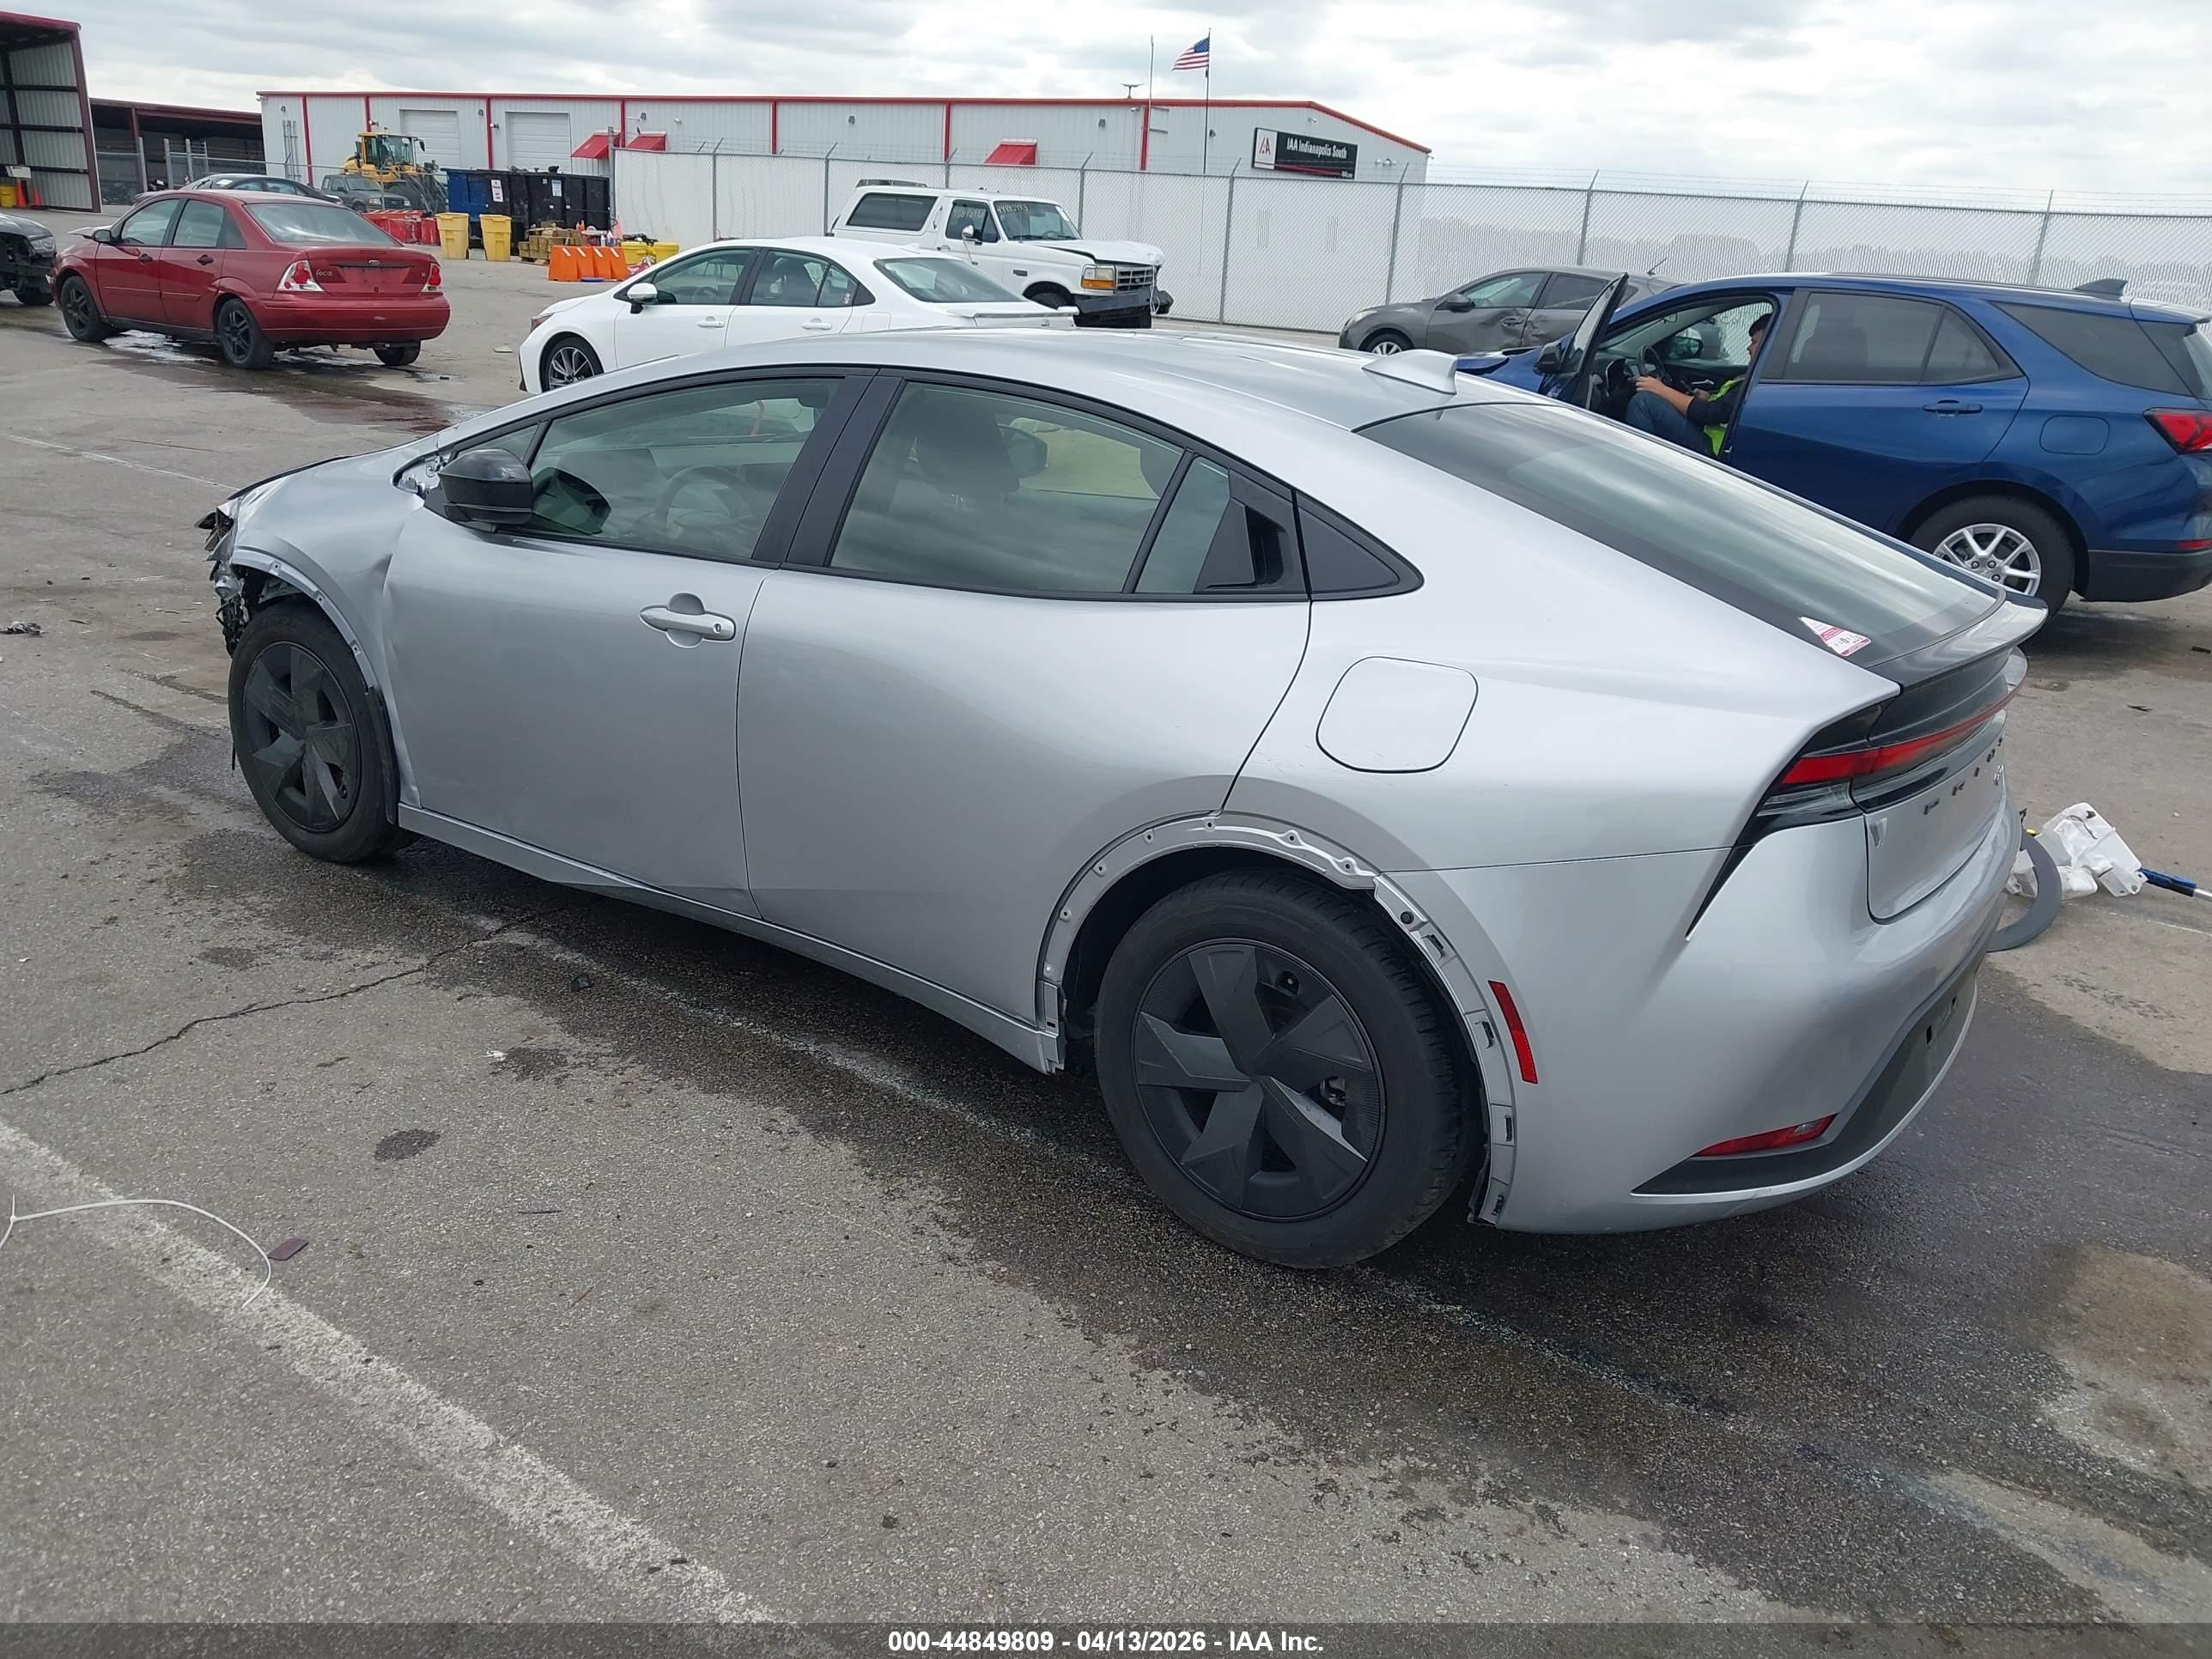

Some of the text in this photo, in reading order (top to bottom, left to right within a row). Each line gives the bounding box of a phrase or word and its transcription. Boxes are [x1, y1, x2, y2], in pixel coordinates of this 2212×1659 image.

[1286, 137, 1347, 159] IAA Indianapolis South
